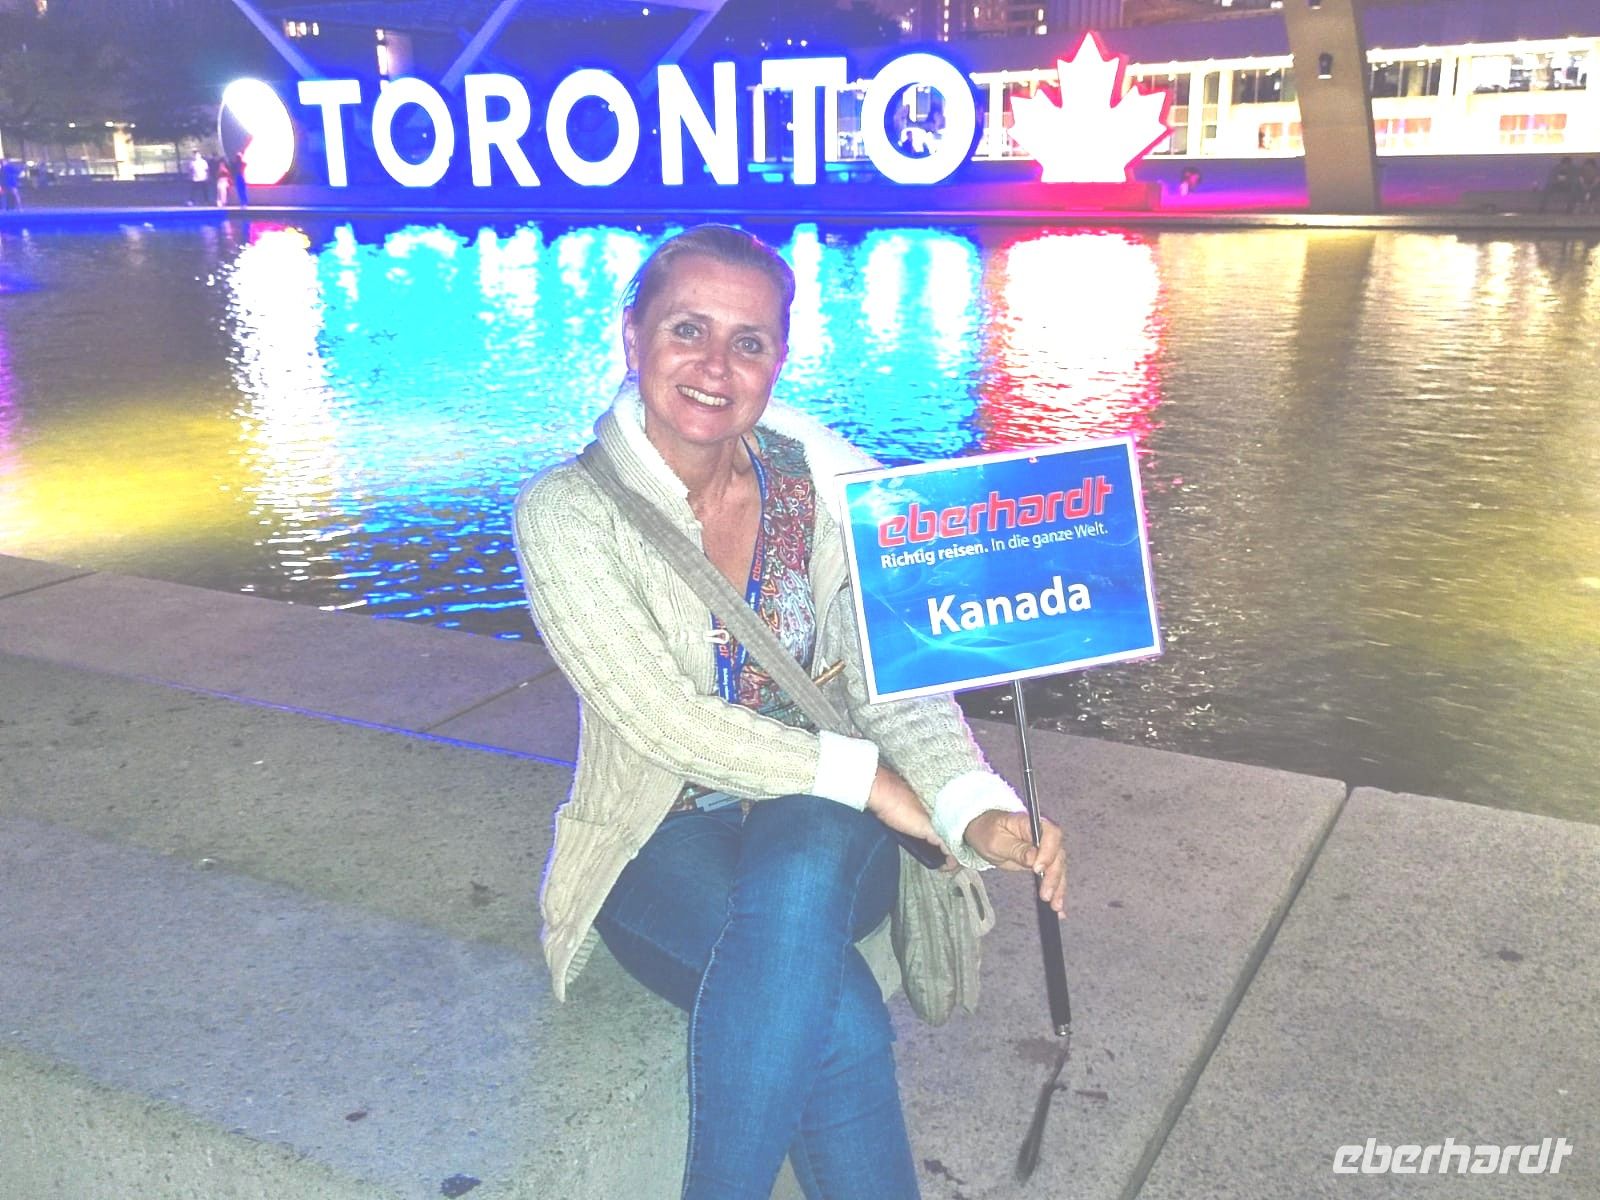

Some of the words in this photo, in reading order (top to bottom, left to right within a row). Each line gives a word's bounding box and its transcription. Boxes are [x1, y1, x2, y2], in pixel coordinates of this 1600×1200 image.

[298, 53, 976, 187] TORONTO
[879, 475, 1113, 548] eberhardt
[880, 549, 936, 569] Richtig
[938, 542, 989, 561] reisen.
[991, 537, 1005, 552] In
[1007, 533, 1030, 549] die
[1032, 529, 1073, 548] ganze
[1074, 521, 1109, 539] Welt.
[927, 575, 1092, 636] Kanada
